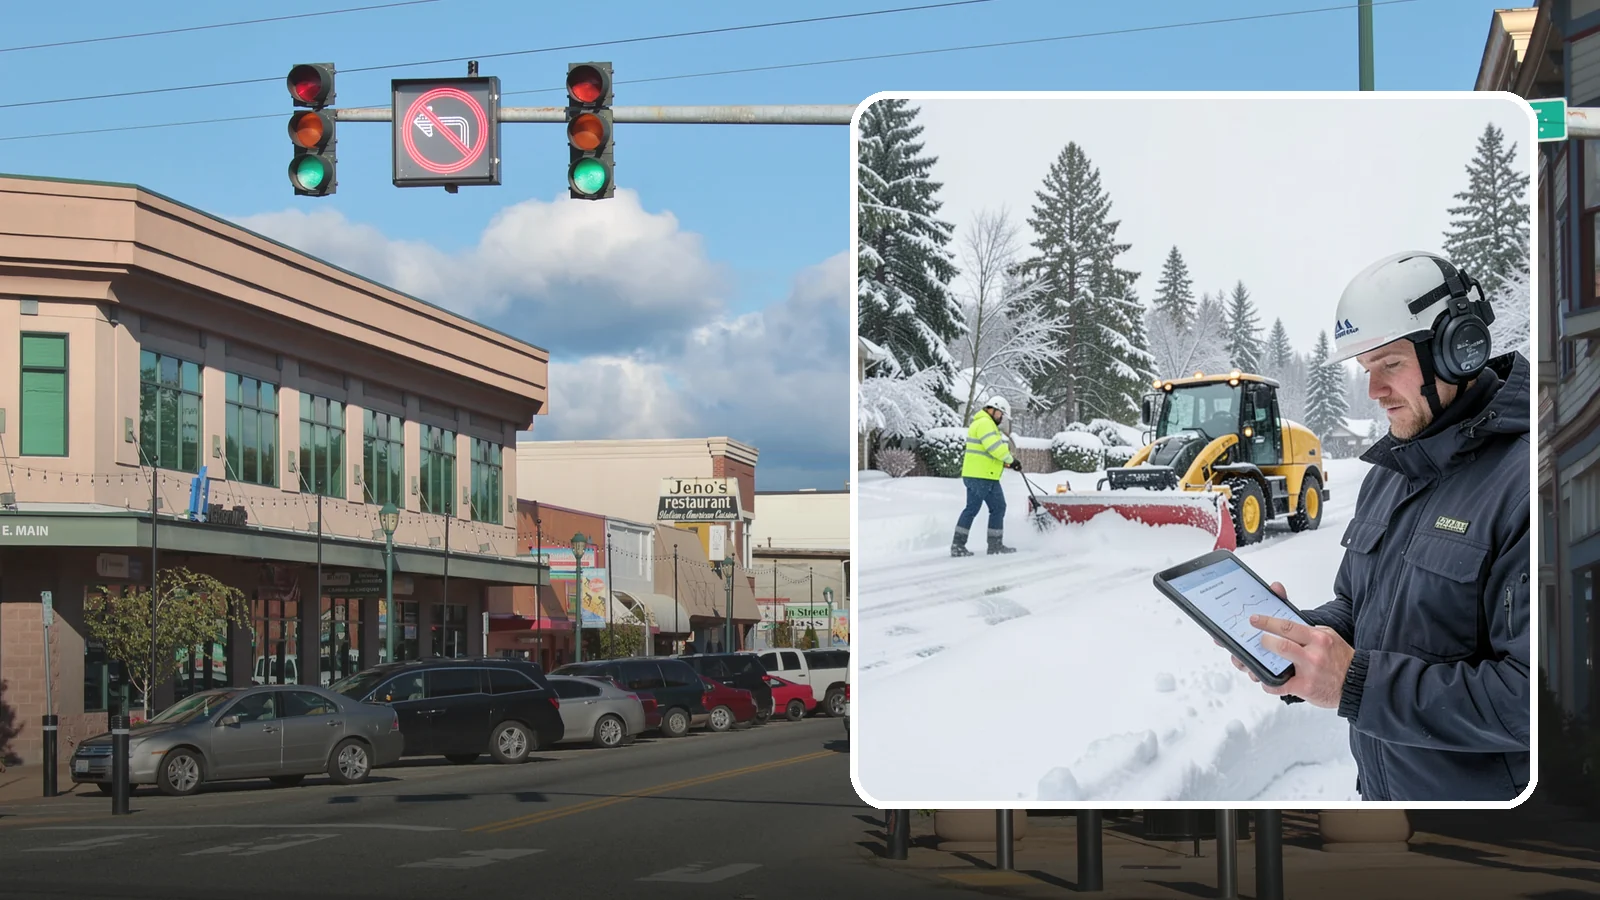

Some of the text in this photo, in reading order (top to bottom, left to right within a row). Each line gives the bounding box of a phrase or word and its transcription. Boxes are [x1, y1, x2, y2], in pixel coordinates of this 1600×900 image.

[669, 480, 727, 494] Jeno's
[665, 497, 731, 509] restaurant
[686, 510, 714, 519] American
[715, 509, 737, 519] Cuisine
[2, 525, 49, 536] E. MAIN
[797, 607, 829, 617] Street
